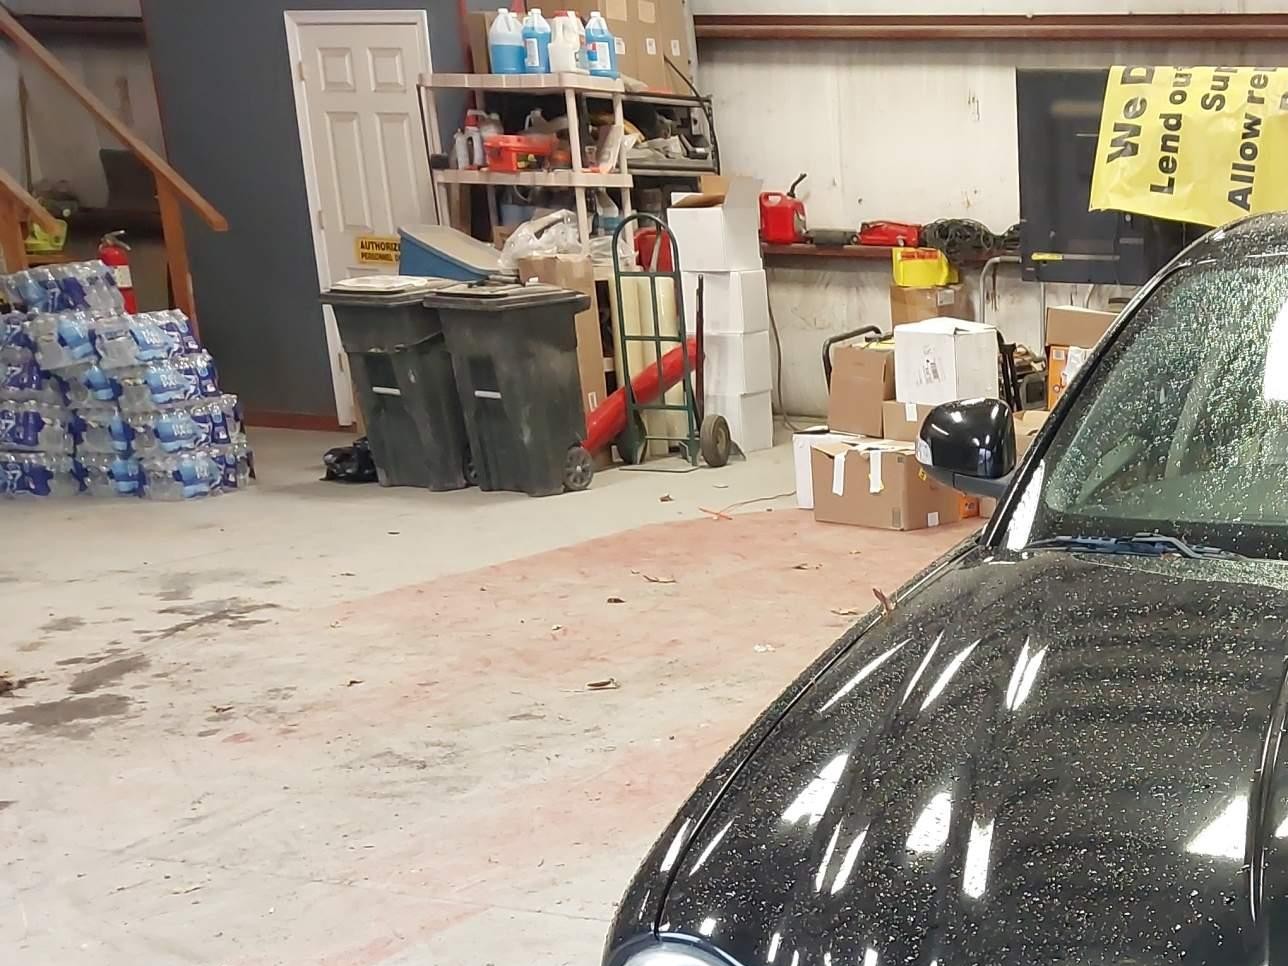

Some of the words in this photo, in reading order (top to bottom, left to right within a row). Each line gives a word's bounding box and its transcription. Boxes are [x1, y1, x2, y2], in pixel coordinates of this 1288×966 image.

[1106, 96, 1148, 164] We
[1150, 113, 1183, 195] Lend
[1228, 112, 1263, 211] Allow
